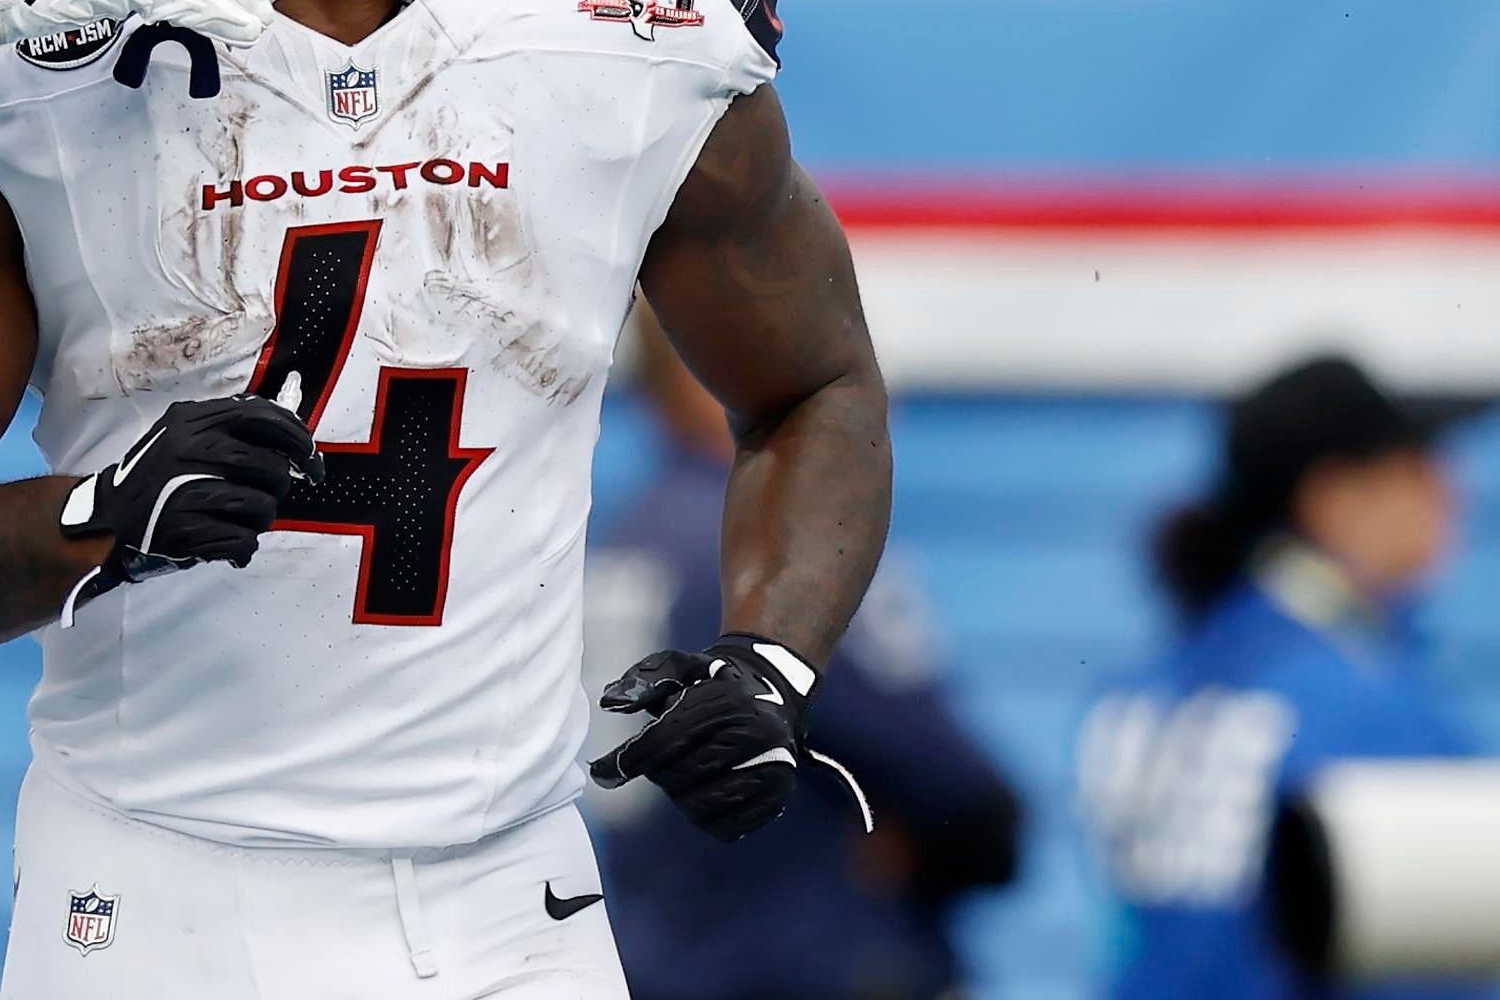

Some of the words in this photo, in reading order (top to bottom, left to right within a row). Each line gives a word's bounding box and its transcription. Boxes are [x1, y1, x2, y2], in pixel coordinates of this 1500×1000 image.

[28, 31, 69, 57] RCM
[75, 19, 112, 46] JSM
[335, 90, 373, 116] NFL
[201, 158, 509, 211] HOUSTON
[242, 218, 497, 627] 4
[70, 914, 105, 942] NFL
